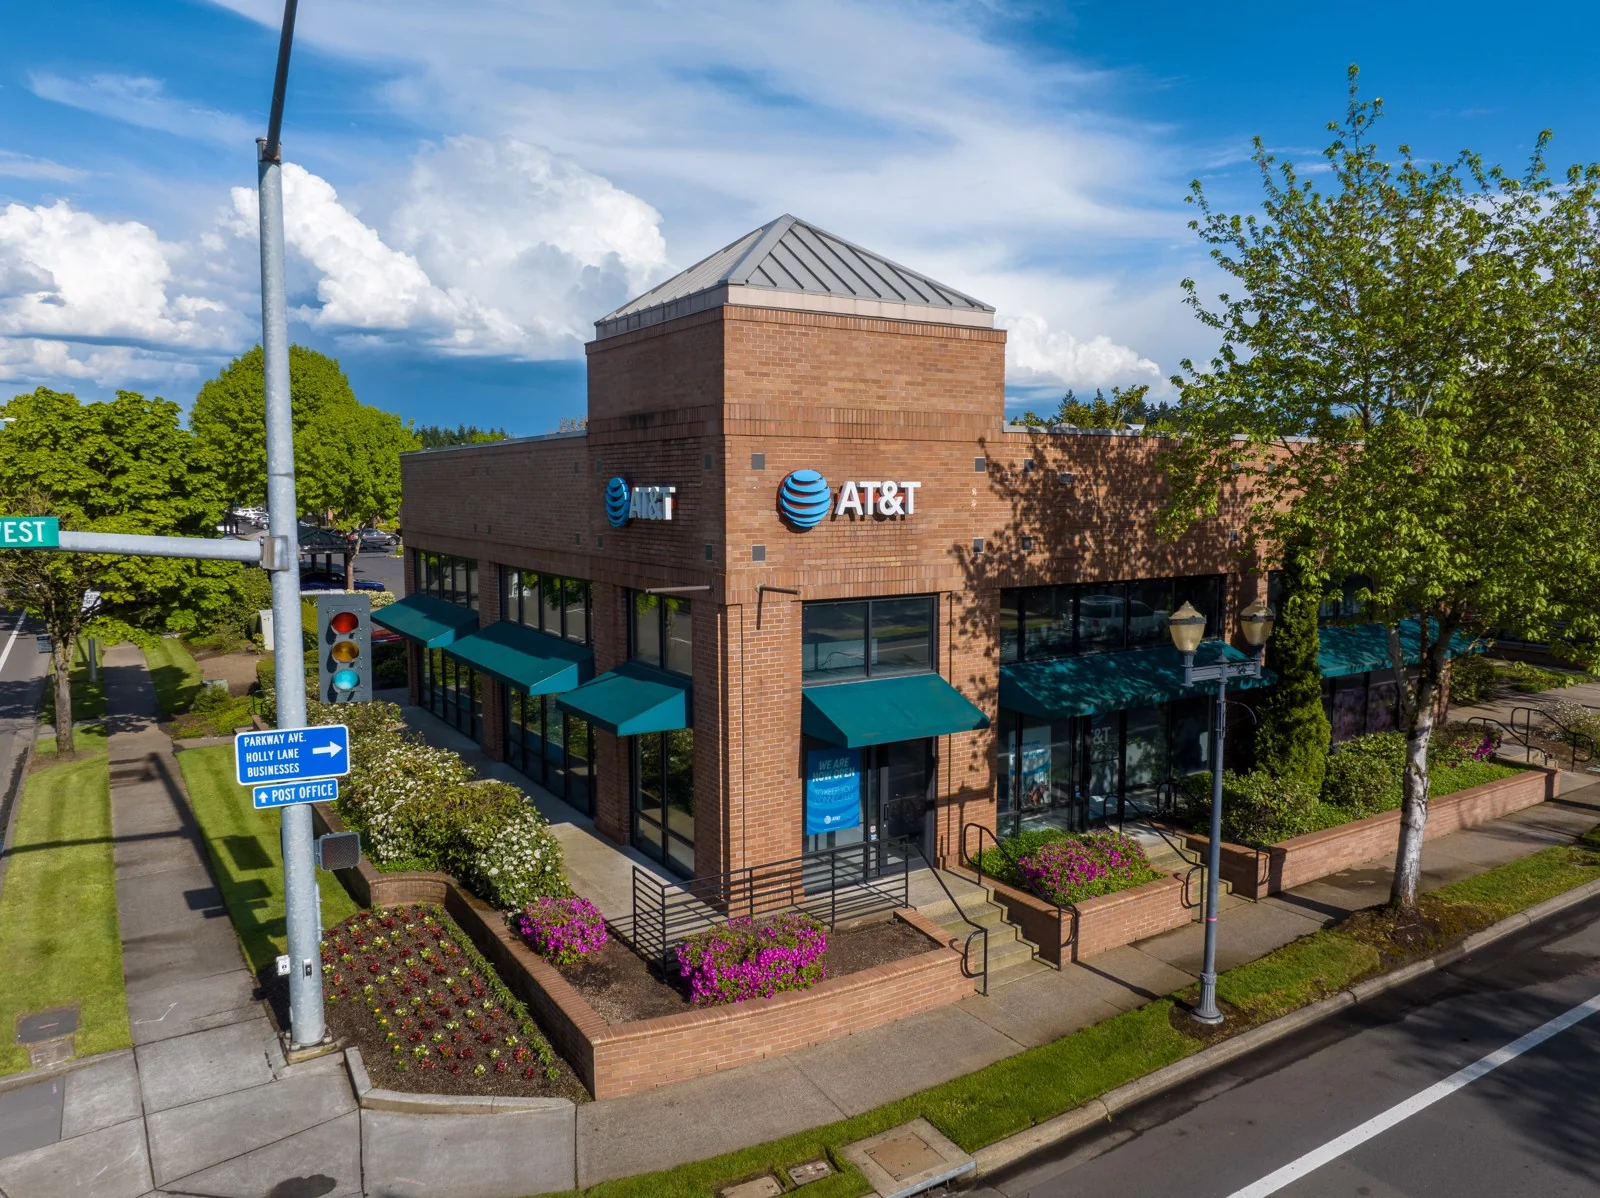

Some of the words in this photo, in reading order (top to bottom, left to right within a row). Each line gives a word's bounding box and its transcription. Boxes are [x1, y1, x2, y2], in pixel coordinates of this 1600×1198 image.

[628, 486, 676, 520] AT&T
[836, 480, 921, 516] AT&T
[0, 521, 46, 543] EST
[244, 734, 285, 747] PARKWAY
[288, 732, 307, 743] AVE.
[246, 750, 274, 763] HOLLY
[277, 748, 300, 760] LANE
[247, 763, 300, 778] BUSINESSES
[819, 759, 832, 770] WE
[833, 757, 850, 769] ARE
[812, 770, 831, 782] NOW
[834, 767, 855, 778] OPEN
[272, 787, 296, 802] POST
[298, 783, 334, 799] OFFICE
[824, 786, 840, 795] KEEP
